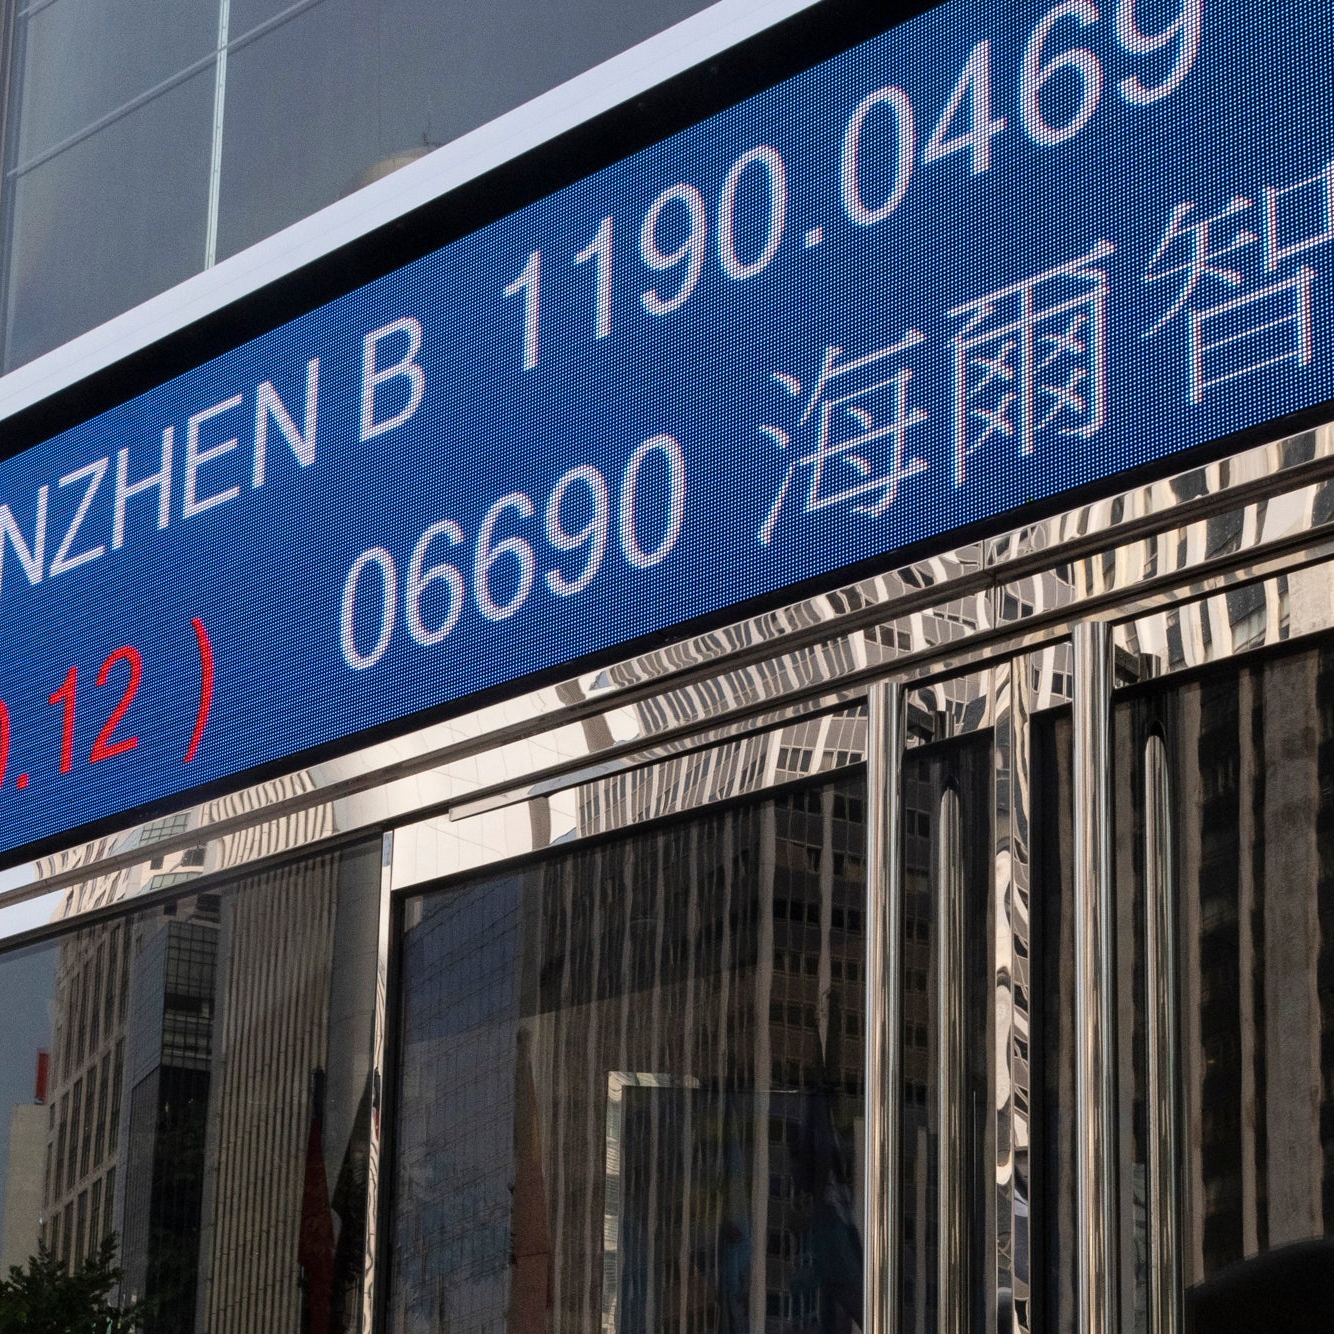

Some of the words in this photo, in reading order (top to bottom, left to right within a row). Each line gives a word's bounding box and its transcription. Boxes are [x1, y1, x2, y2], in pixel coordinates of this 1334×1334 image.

[359, 316, 427, 442] B
[503, 0, 1203, 371] 1190.0469
[341, 433, 687, 671] 06690
